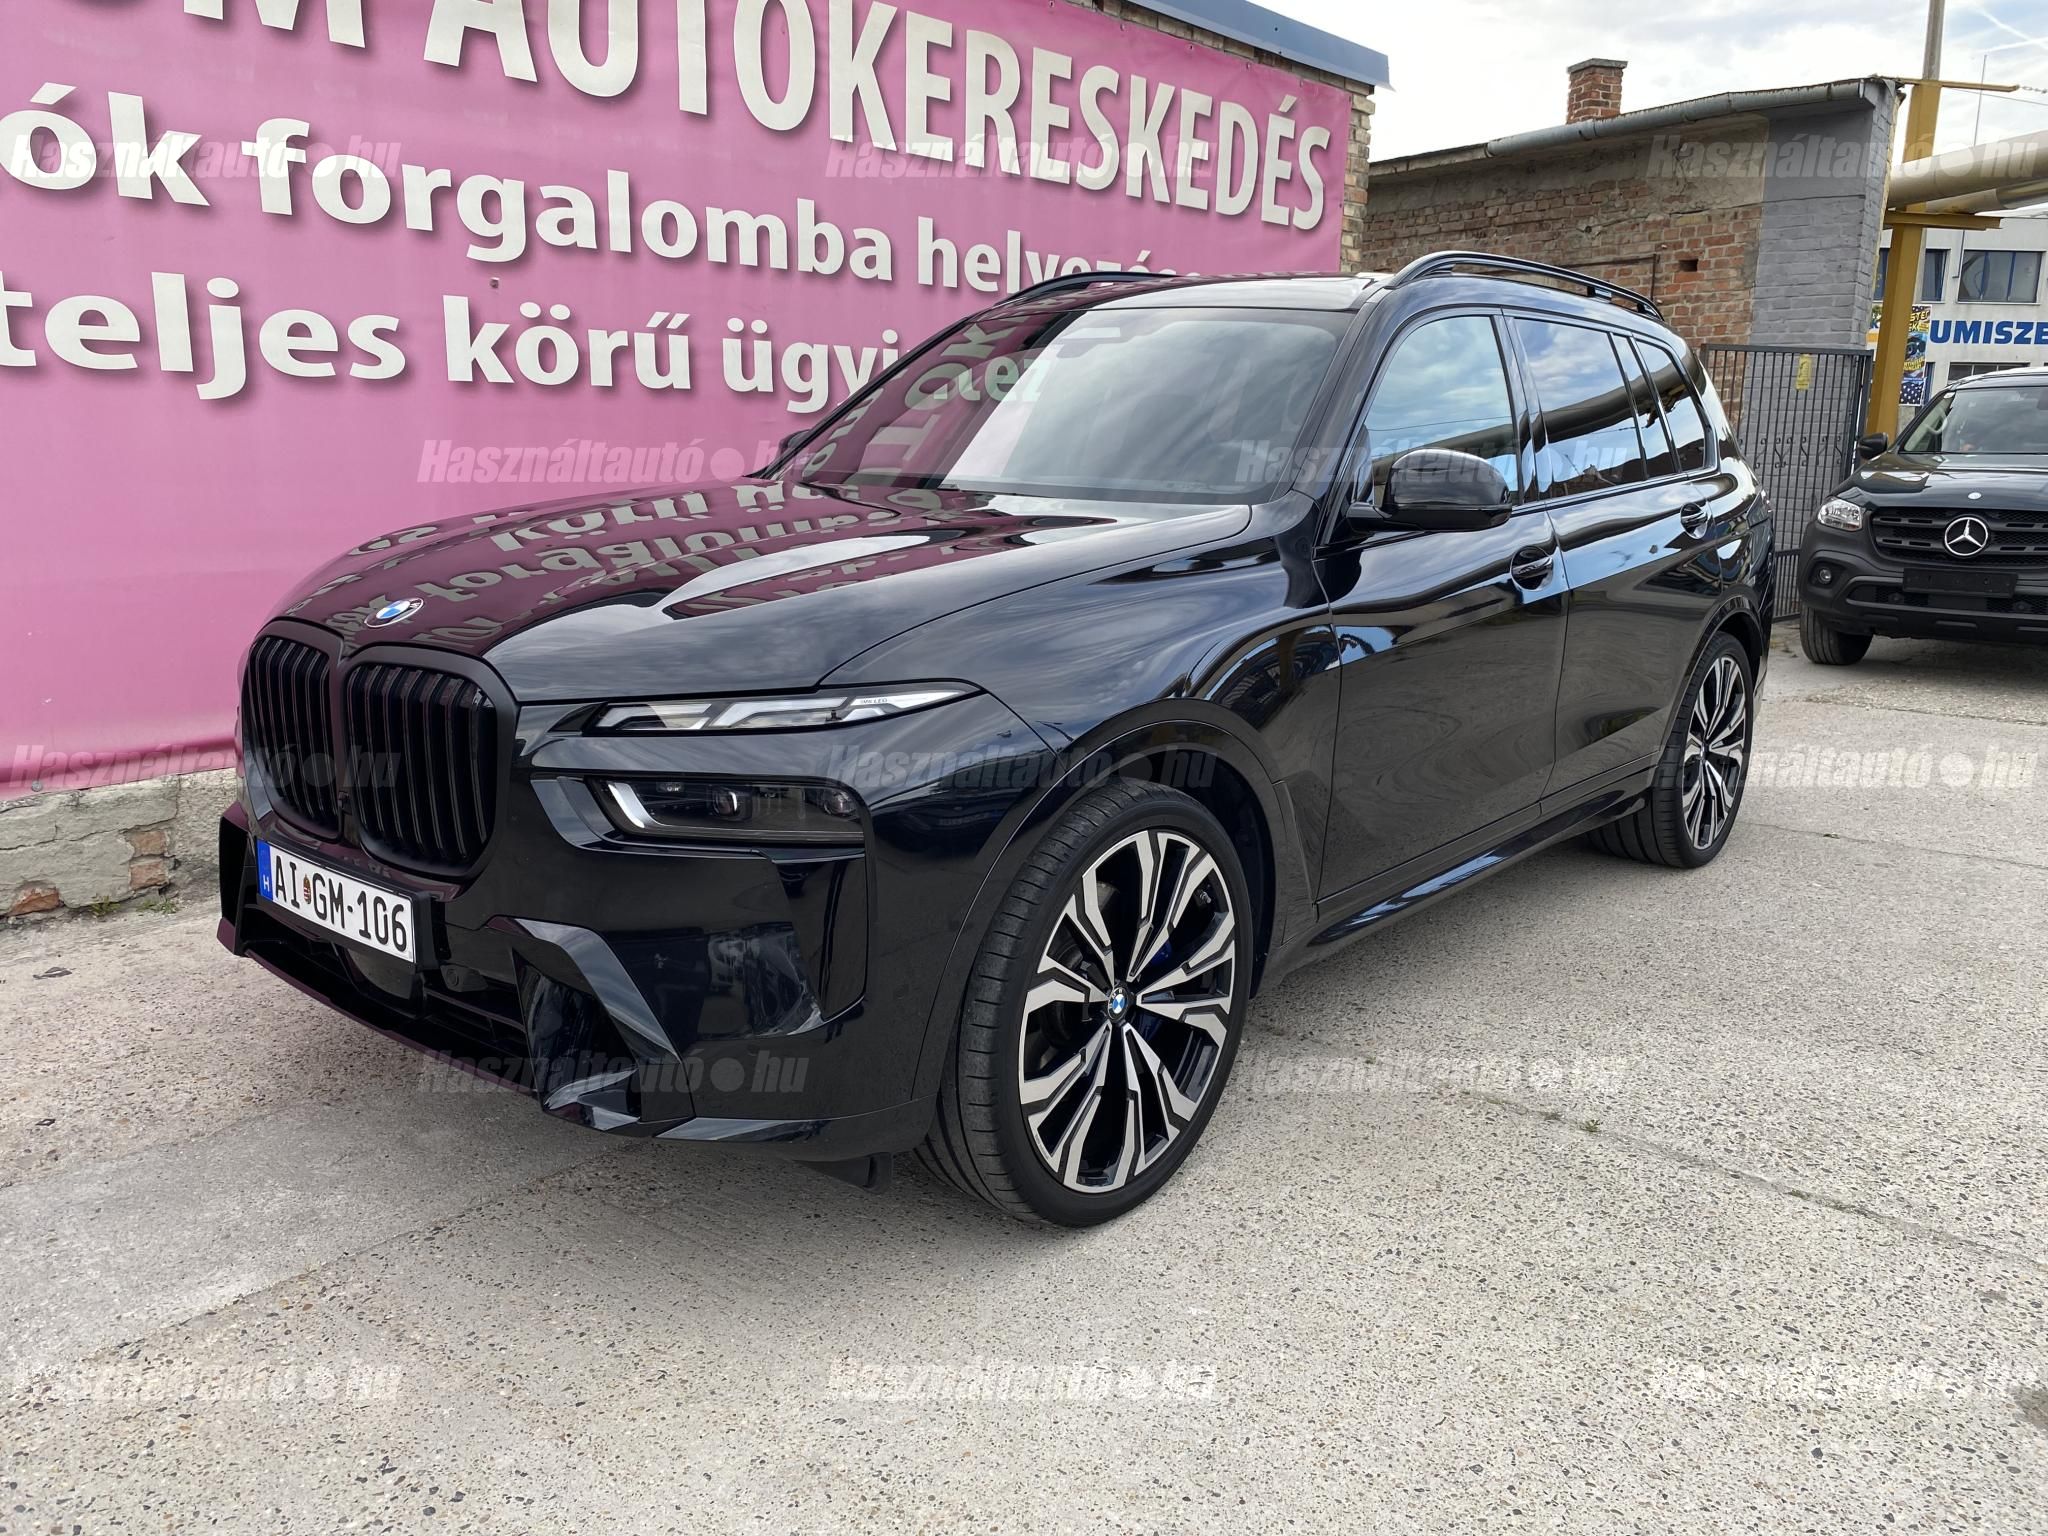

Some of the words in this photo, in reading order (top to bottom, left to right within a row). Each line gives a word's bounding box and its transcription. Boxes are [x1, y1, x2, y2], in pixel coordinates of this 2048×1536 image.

[241, 118, 892, 283] forgalomba
[443, 295, 691, 390] körű
[263, 875, 270, 891] H
